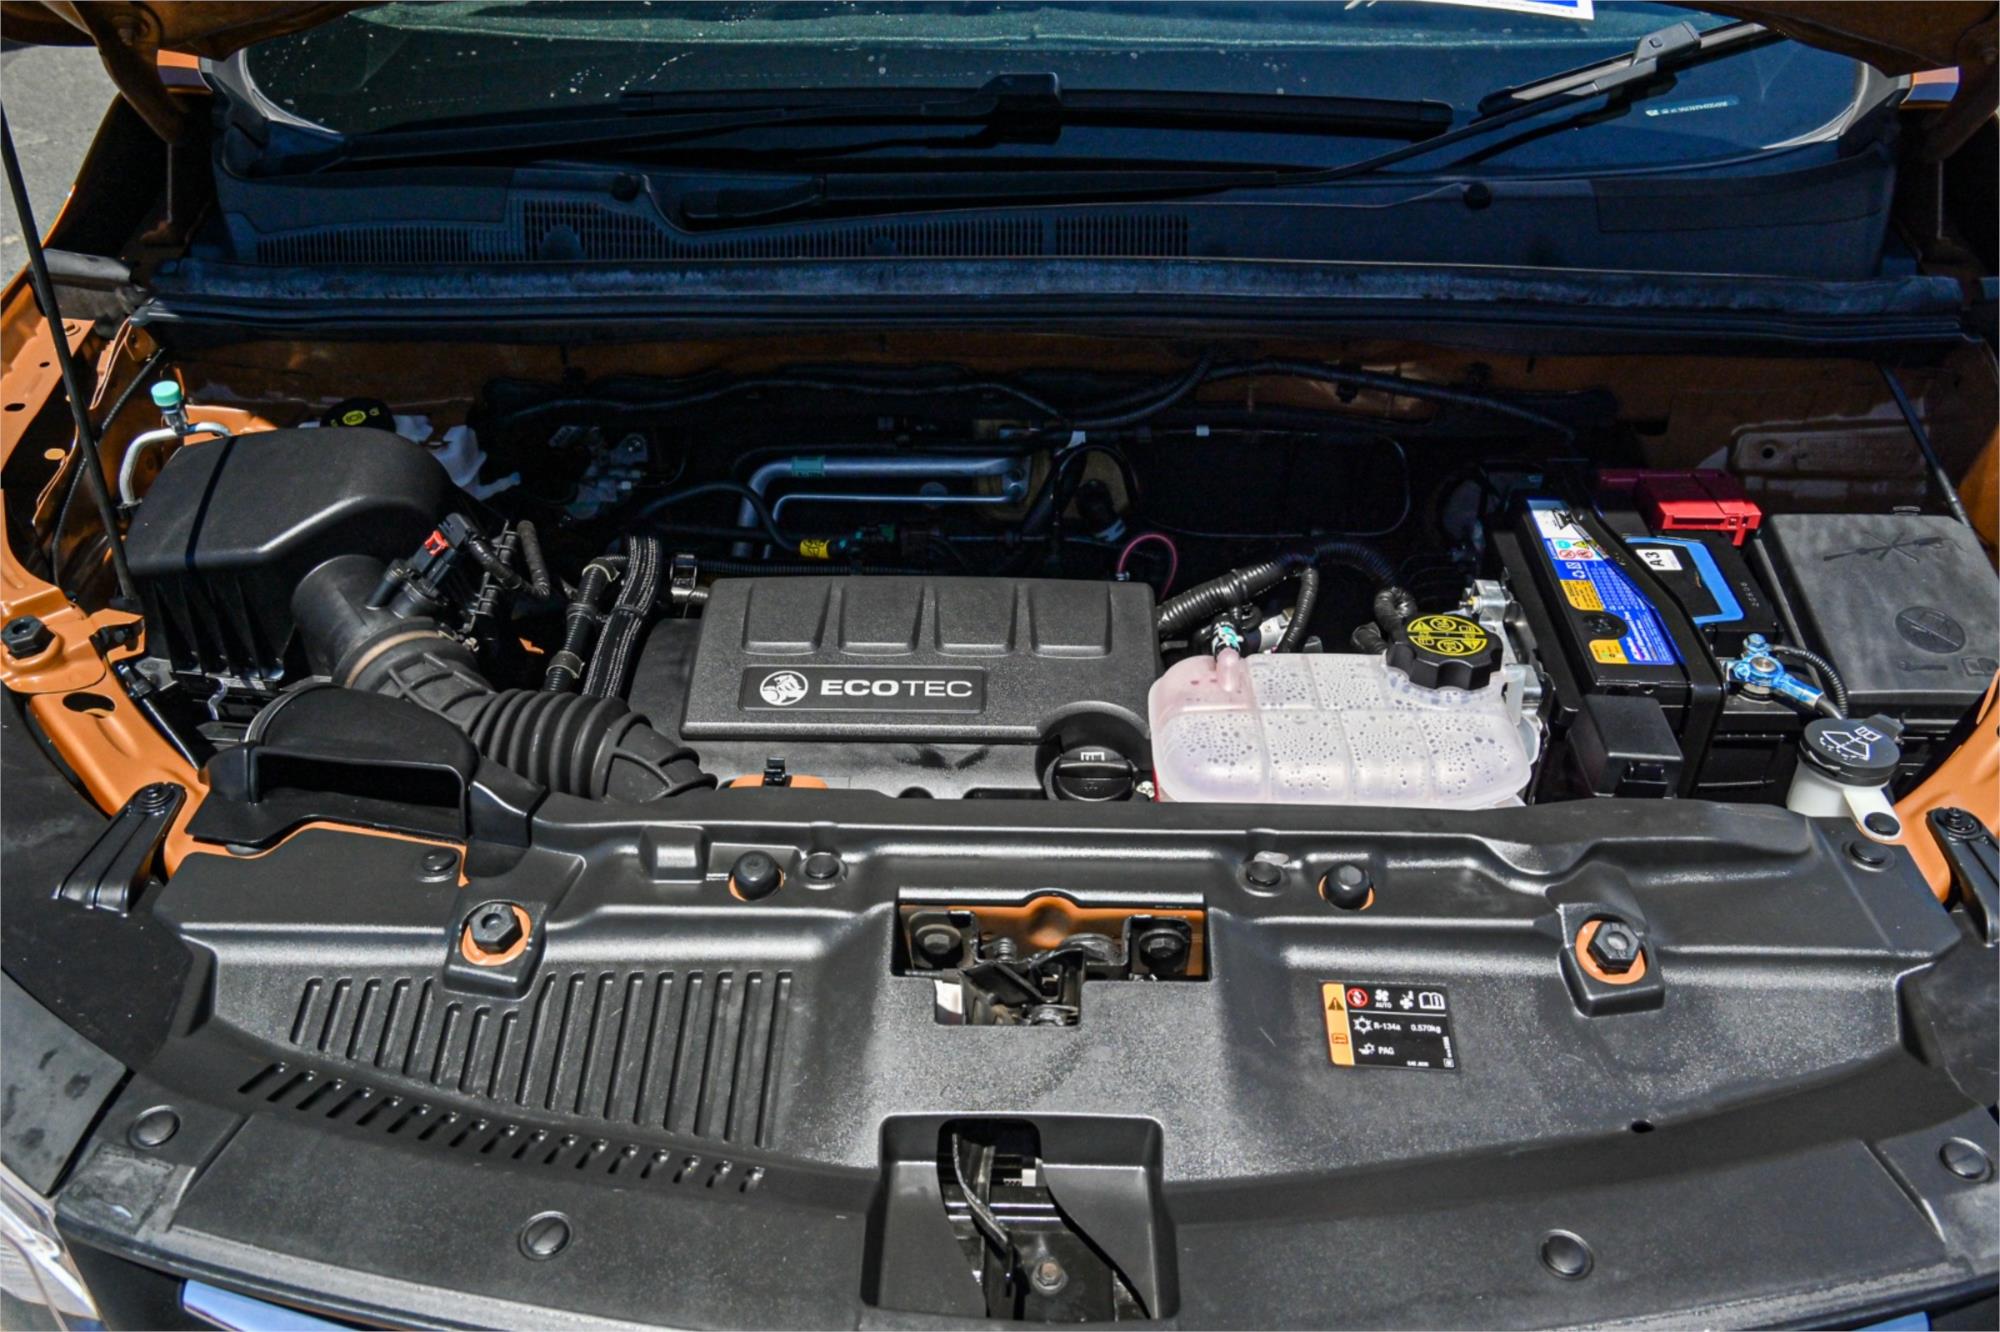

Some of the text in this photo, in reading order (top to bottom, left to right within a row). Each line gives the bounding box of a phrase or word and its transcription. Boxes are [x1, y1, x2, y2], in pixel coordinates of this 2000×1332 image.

[1645, 552, 1664, 567] A3
[820, 679, 973, 697] ECOTEC
[1373, 1021, 1442, 1034] R-134a 0.570kg
[1377, 1046, 1395, 1056] PAG
